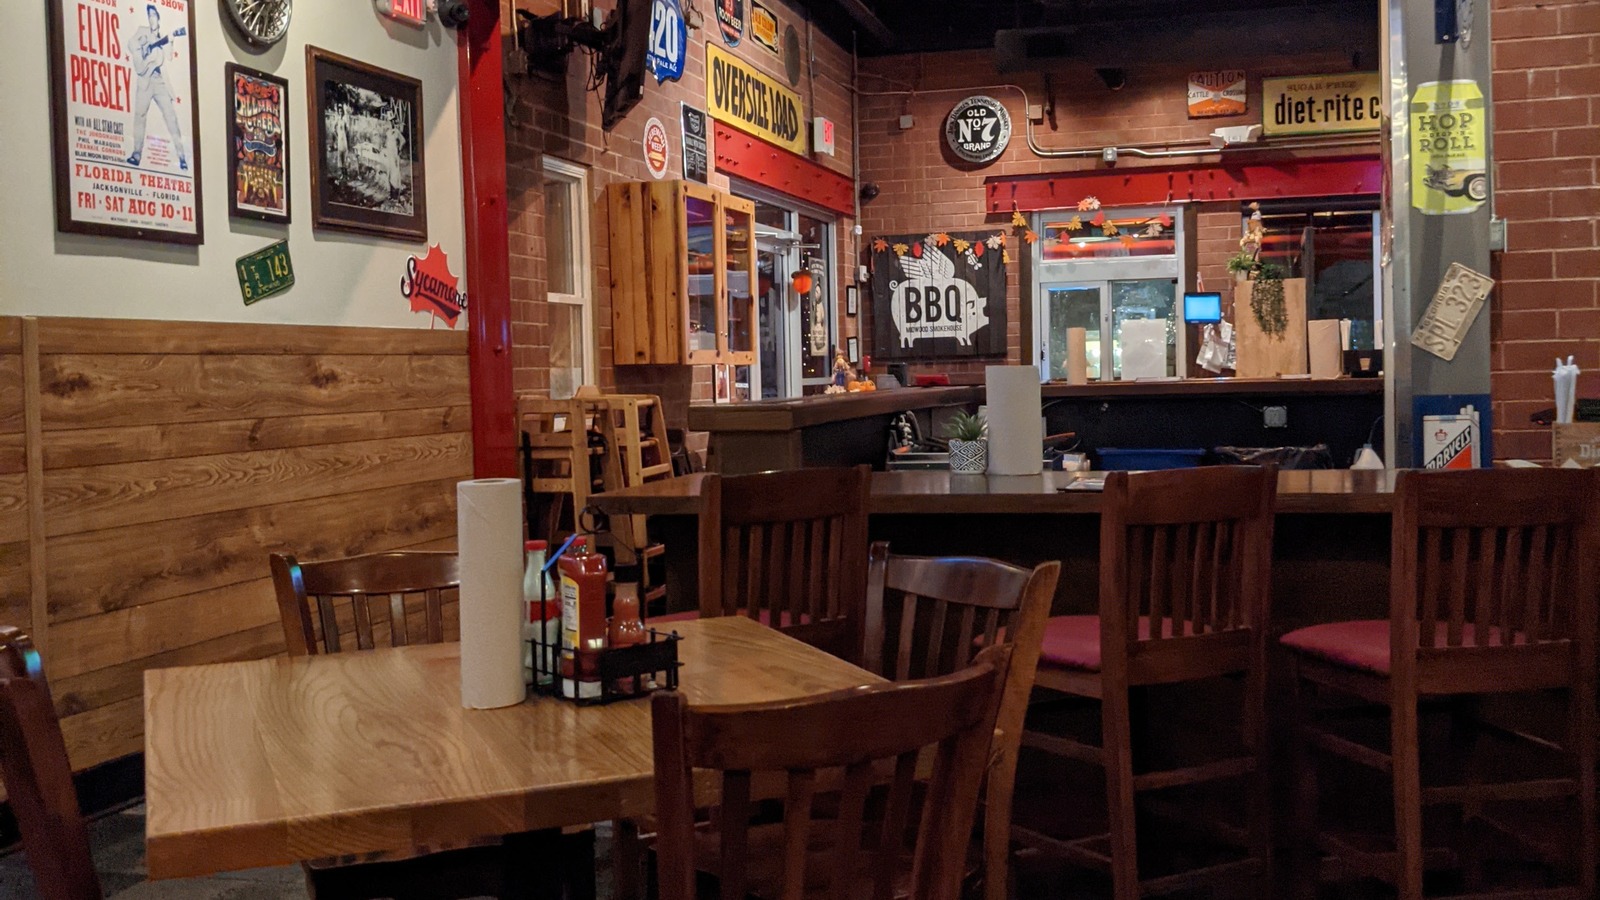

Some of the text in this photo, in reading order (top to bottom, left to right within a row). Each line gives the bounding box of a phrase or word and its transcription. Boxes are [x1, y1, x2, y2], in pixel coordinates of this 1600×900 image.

[78, 3, 121, 60] ELVIS
[718, 6, 731, 24] ROOT
[730, 16, 742, 30] BEER
[70, 54, 131, 113] PRESLEY
[1190, 72, 1244, 87] CAUTION
[713, 56, 799, 142] OVERSIZE LOAD
[967, 109, 987, 117] OLD
[1275, 93, 1363, 125] diet-rite
[1419, 112, 1473, 132] HOP
[963, 142, 992, 152] BRAND
[1419, 136, 1475, 152] ROLL
[75, 163, 193, 194] FLORIDA THEATRE
[92, 182, 180, 202] JACKSONVILLE FLORIDA
[77, 191, 194, 222] FRI SAT AUG 10 11
[400, 256, 468, 310] Sycamore
[905, 285, 963, 323] BBQ
[1423, 285, 1450, 327] GEORGIA
[906, 325, 928, 333] MIDWOOD
